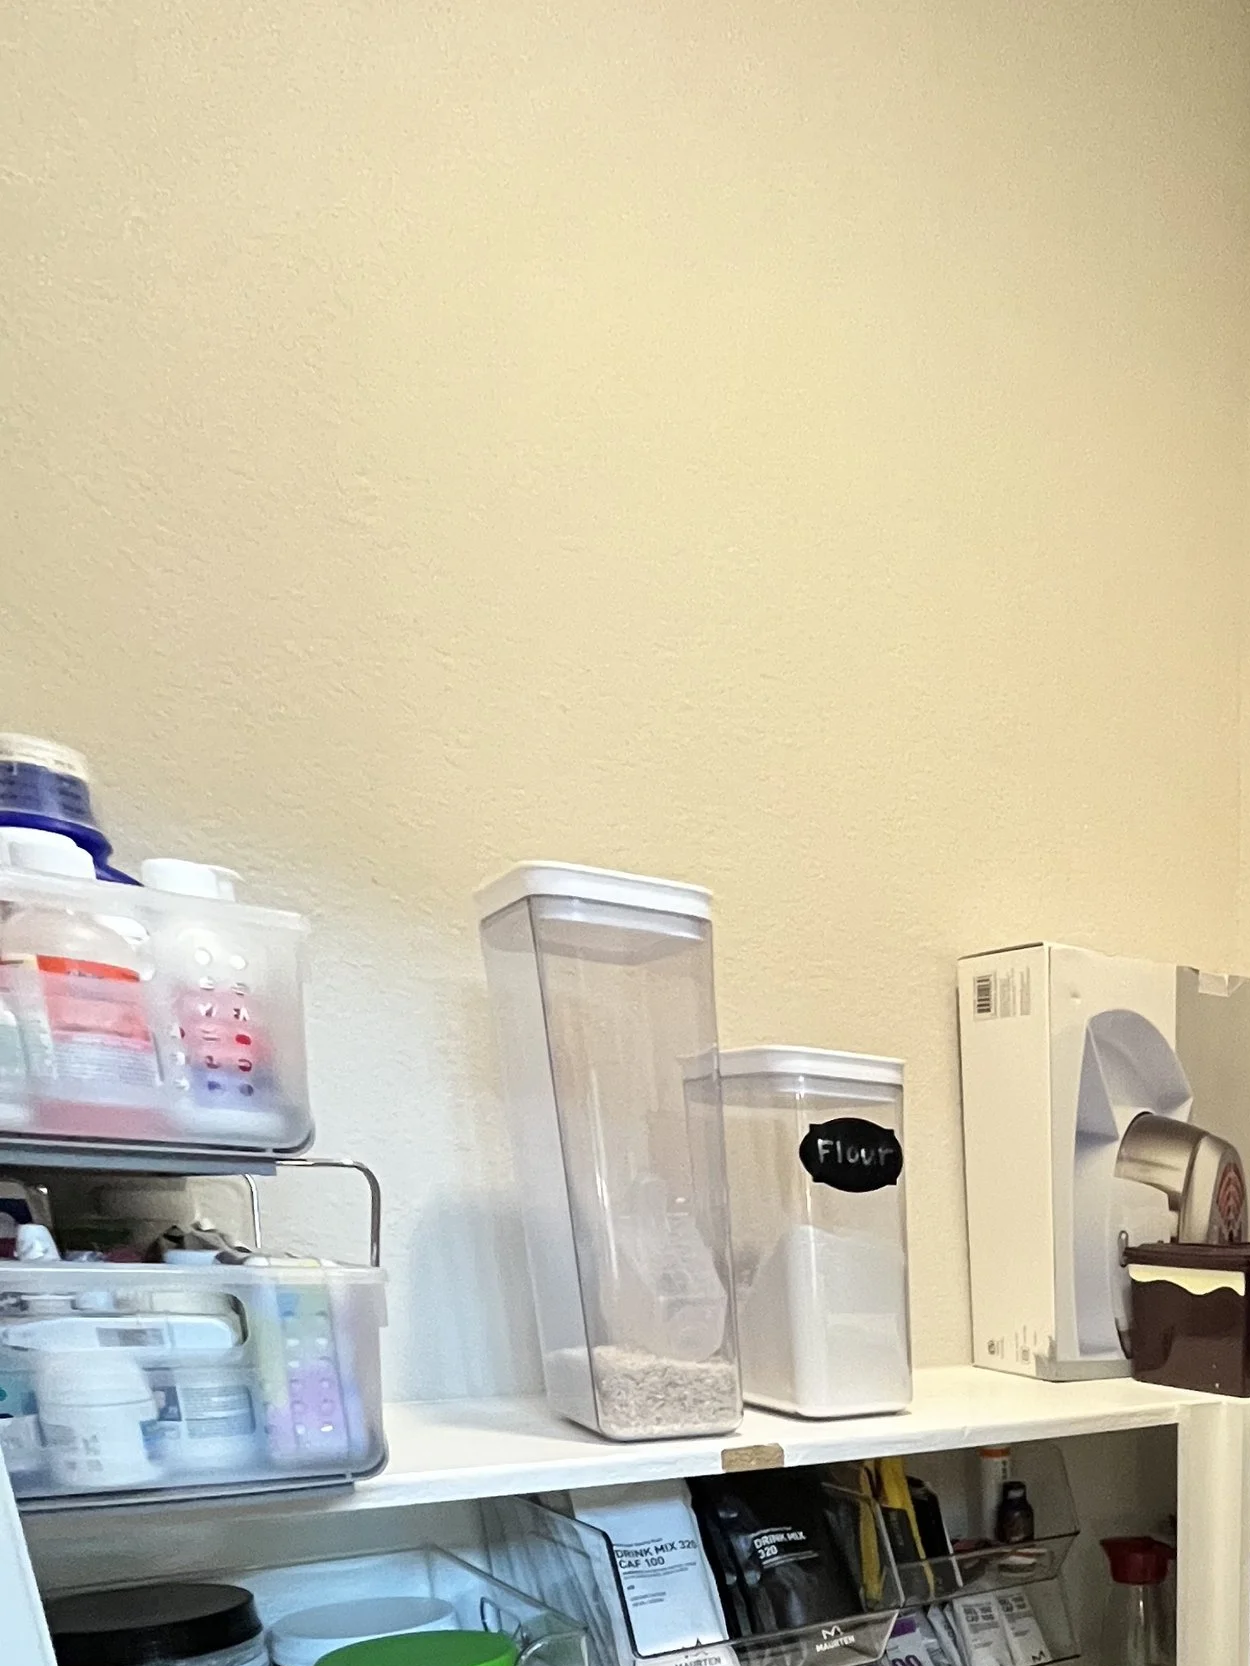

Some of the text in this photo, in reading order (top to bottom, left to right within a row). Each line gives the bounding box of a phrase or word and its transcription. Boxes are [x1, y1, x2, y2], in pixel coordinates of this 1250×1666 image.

[817, 1138, 894, 1166] Flour
[616, 1546, 653, 1559] DRINK
[654, 1542, 677, 1555] MIX
[754, 1535, 786, 1550] DRINK
[757, 1544, 779, 1560] 320
[618, 1556, 665, 1570] CAF 100
[816, 1635, 855, 1653] MAURTEN
